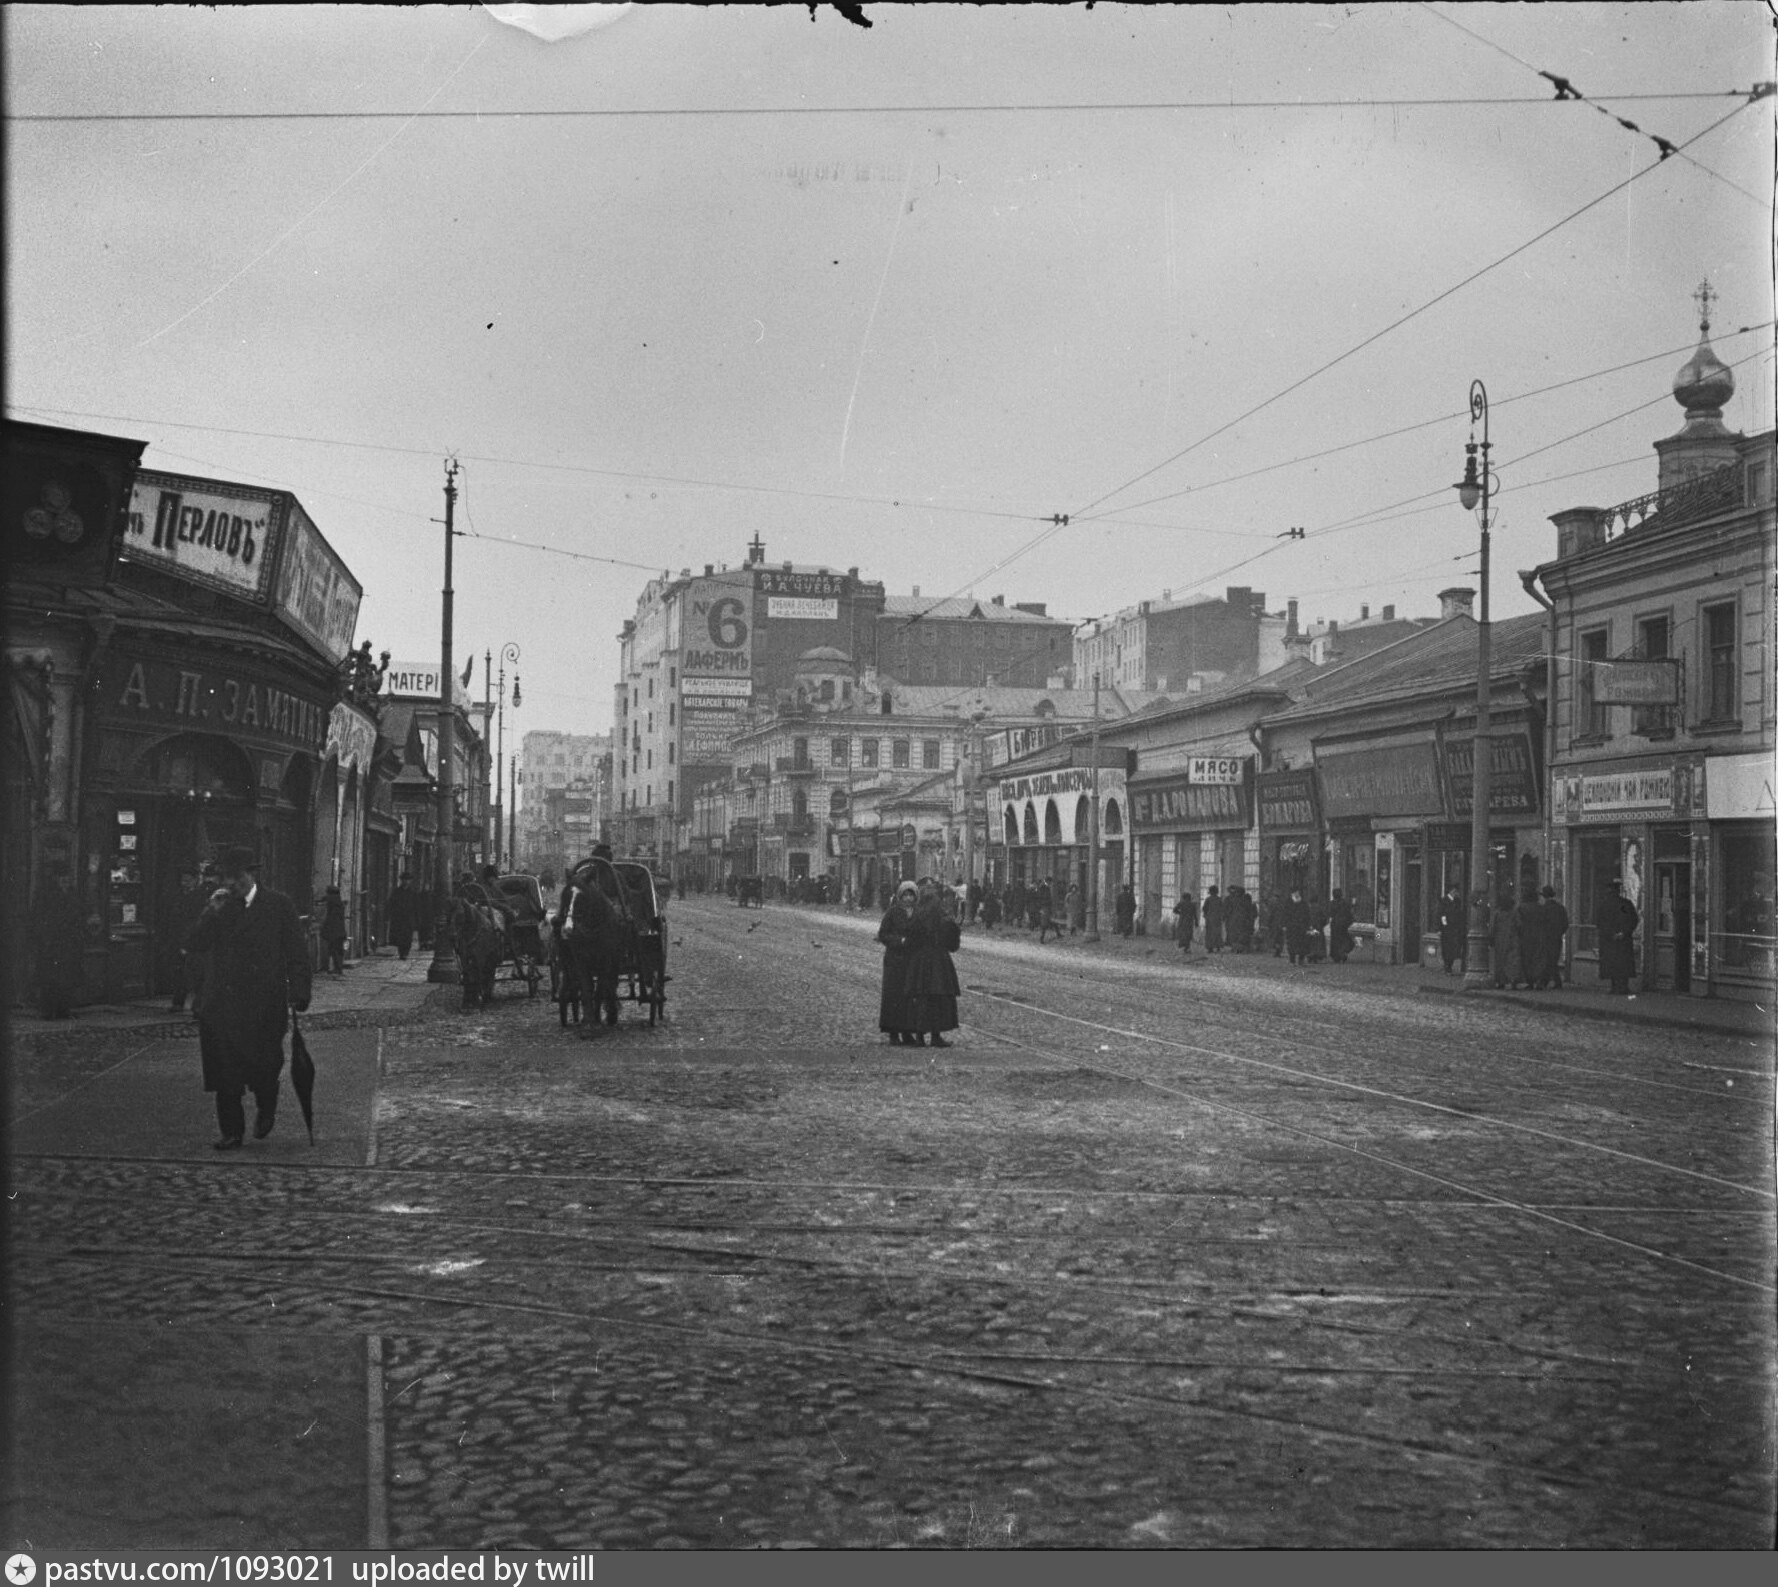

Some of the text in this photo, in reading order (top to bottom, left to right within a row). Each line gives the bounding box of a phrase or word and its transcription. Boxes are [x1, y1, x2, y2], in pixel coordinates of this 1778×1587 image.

[794, 583, 842, 594] ЧУЕВА
[707, 597, 748, 649] 6
[684, 650, 749, 670] ЛАФЕРМЪ
[1194, 761, 1239, 775] МЯСО
